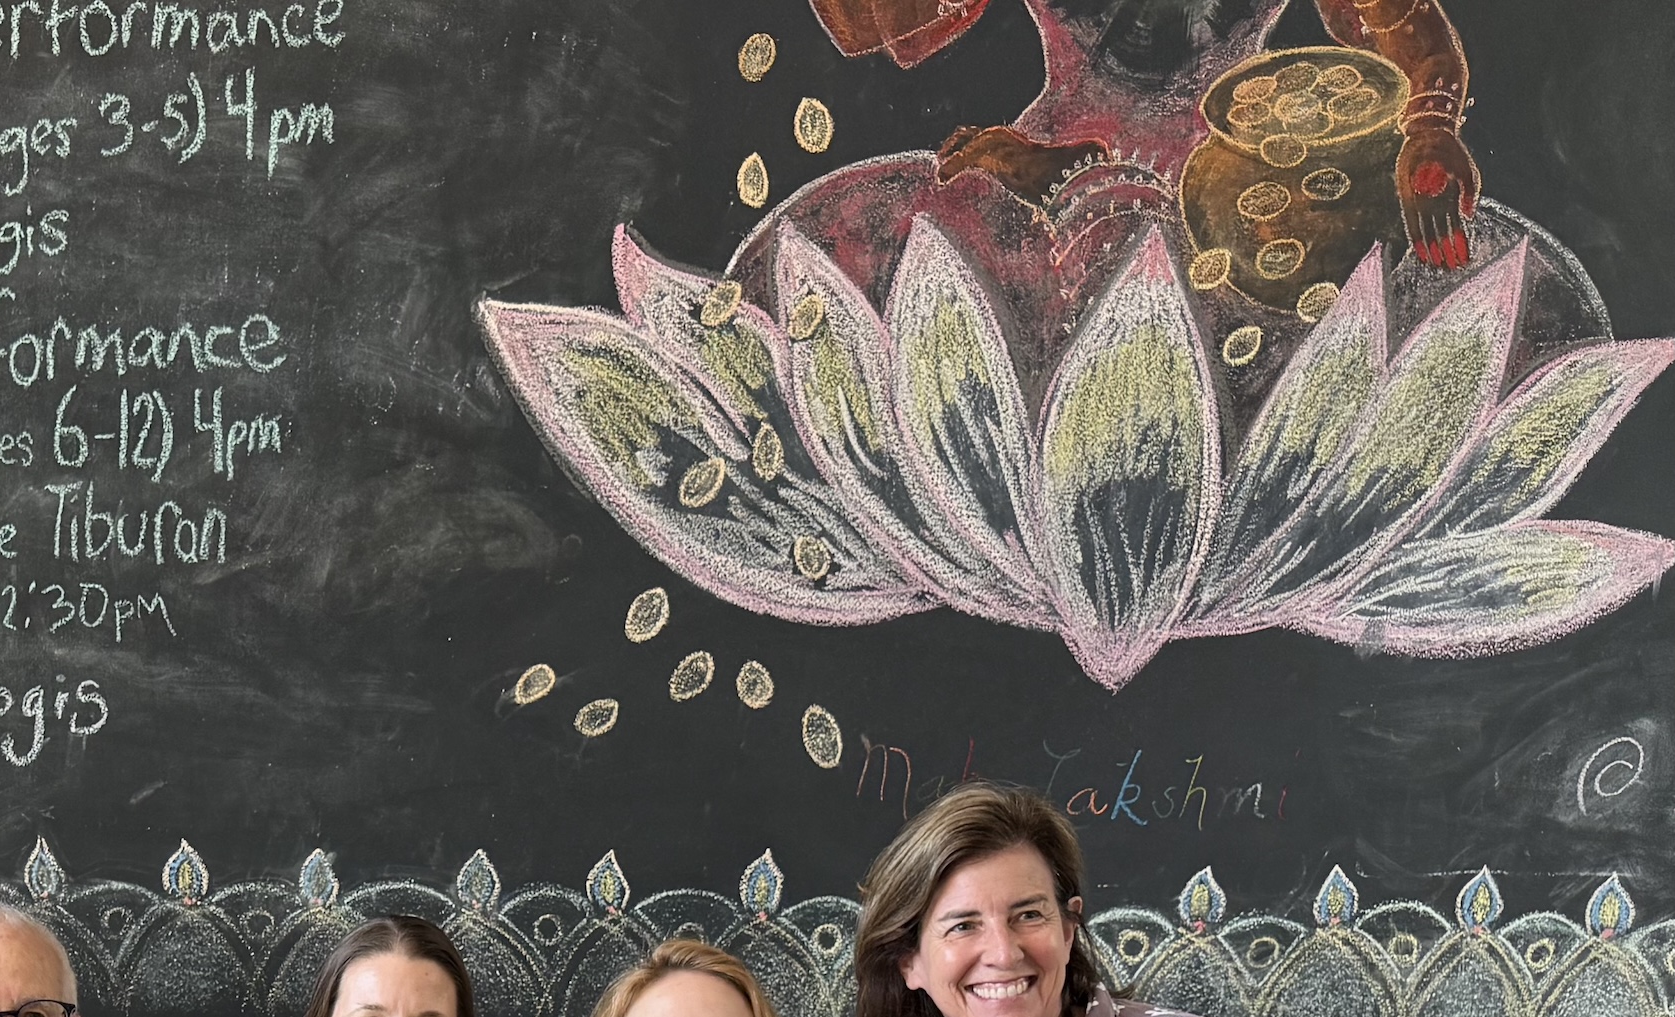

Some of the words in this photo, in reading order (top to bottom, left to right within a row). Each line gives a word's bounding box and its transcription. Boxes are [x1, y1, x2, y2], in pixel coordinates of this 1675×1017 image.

[98, 72, 207, 164] 3-5)
[53, 386, 174, 482] 6-12)
[194, 387, 282, 481] 4pm
